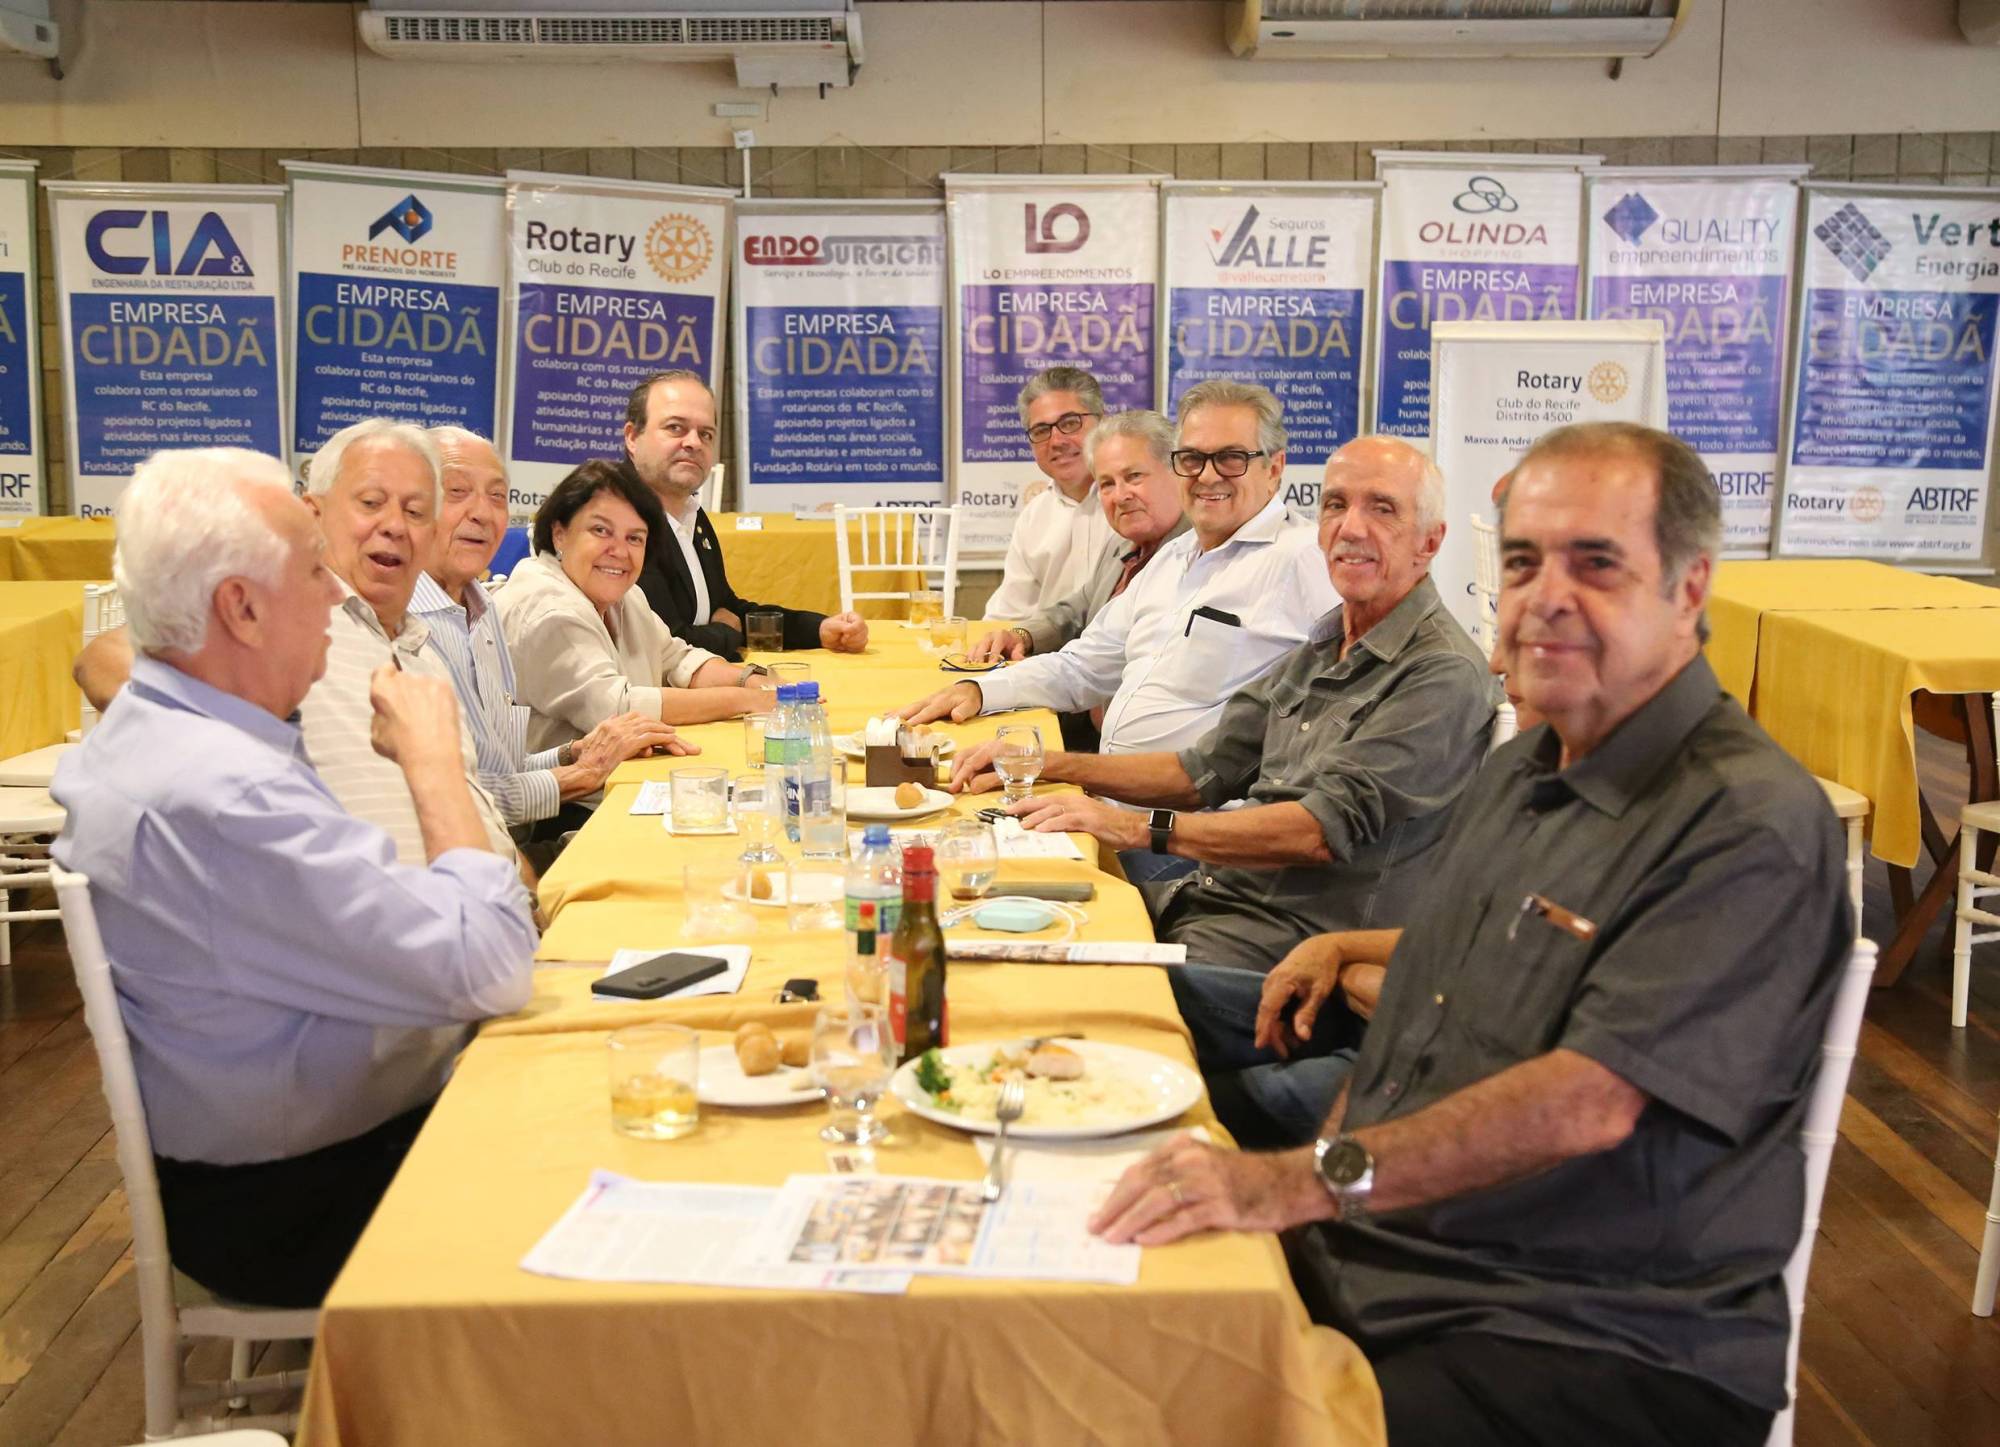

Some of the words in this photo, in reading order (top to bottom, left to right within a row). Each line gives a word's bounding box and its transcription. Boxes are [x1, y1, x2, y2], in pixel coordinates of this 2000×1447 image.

[1025, 203, 1090, 253] LO
[1269, 217, 1325, 231] Seguros
[1661, 218, 1780, 244] QUALITY
[1205, 204, 1330, 268] VALLE
[1419, 221, 1548, 245] OLINDA
[85, 209, 254, 276] CIA
[230, 256, 244, 273] &
[526, 220, 636, 263] Rotary
[343, 245, 457, 269] PRENORTE
[1609, 249, 1778, 267] empreendimentos
[528, 259, 561, 274] Club
[567, 263, 584, 275] do
[589, 263, 636, 279] Recife
[983, 269, 1001, 280] LO
[1005, 268, 1132, 279] EMPREENDIMENTOS
[1915, 255, 2000, 281] Energia
[92, 279, 149, 288] ENGENHARIA
[151, 279, 163, 288] DA
[165, 280, 229, 291] RESTAURAÇÃO
[1422, 268, 1531, 291] EMPRESA
[337, 283, 449, 312] EMPRESA
[1630, 283, 1738, 305] EMPRESA
[557, 293, 666, 320] EMPRESA
[999, 292, 1108, 312] EMPRESA
[1208, 295, 1316, 317] EMPRESA
[1388, 285, 1562, 330] CIDADÃ
[1843, 296, 1953, 320] EMPRESA
[110, 302, 226, 324] EMPRESA
[306, 304, 486, 356] CIDADÃ
[784, 314, 895, 335] EMPRESA
[969, 305, 1144, 353] CIDADÃ
[524, 314, 702, 364] CIDADÃ
[1176, 309, 1350, 358] CIDADÃ
[80, 318, 267, 367] CIDADÃ
[754, 326, 932, 376] CIDADÃ
[361, 352, 384, 363] Esta
[386, 354, 432, 367] empresa
[532, 359, 578, 370] colabora
[582, 362, 605, 372] com
[608, 364, 621, 373] os
[1024, 358, 1046, 368] Esta
[1048, 359, 1093, 368] empresa
[139, 370, 163, 381] Esta
[166, 371, 212, 382] empresa
[315, 365, 361, 376] colabora
[363, 370, 386, 378] com
[389, 371, 402, 379] os
[404, 371, 458, 383] rotarianos
[461, 375, 475, 385] do
[1177, 370, 1204, 380] Estas
[1207, 370, 1257, 381] empresas
[1259, 370, 1313, 380] colaboram
[1316, 371, 1337, 380] com
[1340, 371, 1351, 380] os
[1679, 366, 1690, 375] os
[1748, 365, 1761, 375] do
[577, 377, 591, 387] RC
[594, 378, 609, 388] do
[979, 375, 1024, 384] colabora
[1121, 374, 1134, 383] do
[1517, 370, 1582, 393] Rotary
[1947, 374, 1969, 384] com
[1972, 375, 1984, 384] os
[95, 385, 141, 395] colabora
[143, 387, 167, 395] com
[170, 388, 182, 396] os
[185, 386, 240, 396] rotarianos
[243, 387, 257, 396] do
[361, 383, 374, 393] RC
[377, 384, 391, 394] do
[757, 388, 784, 398] Estas
[787, 389, 837, 400] empresas
[840, 388, 894, 398] colaboram
[897, 389, 920, 398] com
[922, 389, 934, 398] os
[1275, 384, 1290, 394] RC
[1292, 384, 1324, 395] Recife,
[537, 390, 588, 403] apoiando
[142, 401, 156, 411] RC
[159, 401, 173, 411] do
[322, 396, 371, 408] apoiando
[374, 399, 417, 412] projetos
[420, 402, 457, 415] ligados
[459, 406, 467, 414] a
[782, 403, 835, 412] rotarianos
[838, 403, 852, 412] do
[857, 402, 871, 412] RC
[1288, 399, 1322, 411] ligados
[1496, 398, 1522, 409] Club
[1526, 398, 1541, 409] do
[1545, 399, 1581, 410] Recife
[536, 405, 590, 419] atividades
[593, 410, 612, 419] nas
[1296, 413, 1332, 425] sociais,
[1496, 410, 1540, 422] Distrito
[1543, 412, 1573, 422] 4500
[103, 416, 154, 427] apoiando
[157, 417, 201, 428] projetos
[204, 417, 242, 428] ligados
[244, 419, 251, 427] a
[532, 420, 602, 434] humanitárias
[605, 427, 612, 435] e
[774, 418, 823, 428] apoiando
[826, 418, 867, 430] projetos
[870, 417, 906, 429] ligados
[104, 431, 158, 441] atividades
[161, 433, 179, 442] nas
[183, 432, 211, 442] áreas
[1325, 429, 1337, 439] da
[1745, 426, 1758, 435] da
[535, 436, 587, 451] Fundação
[773, 433, 826, 443] atividades
[849, 433, 877, 442] áreas
[1464, 435, 1499, 445] Marcos
[1502, 436, 1530, 445] André
[1700, 440, 1723, 449] todo
[1953, 434, 1966, 443] da
[771, 448, 839, 457] humanitárias
[841, 449, 848, 457] e
[851, 448, 907, 457] ambientais
[909, 448, 922, 457] da
[967, 448, 1015, 459] Fundação
[1943, 449, 1981, 459] mundo.
[753, 463, 803, 474] Fundação
[806, 463, 843, 472] Rotária
[845, 464, 861, 472] em
[864, 463, 888, 472] todo
[900, 462, 939, 472] mundo.
[510, 489, 547, 505] Rota
[962, 491, 1018, 507] Rotary
[1788, 494, 1845, 512] Rotary
[1907, 487, 1979, 512] ABTRF
